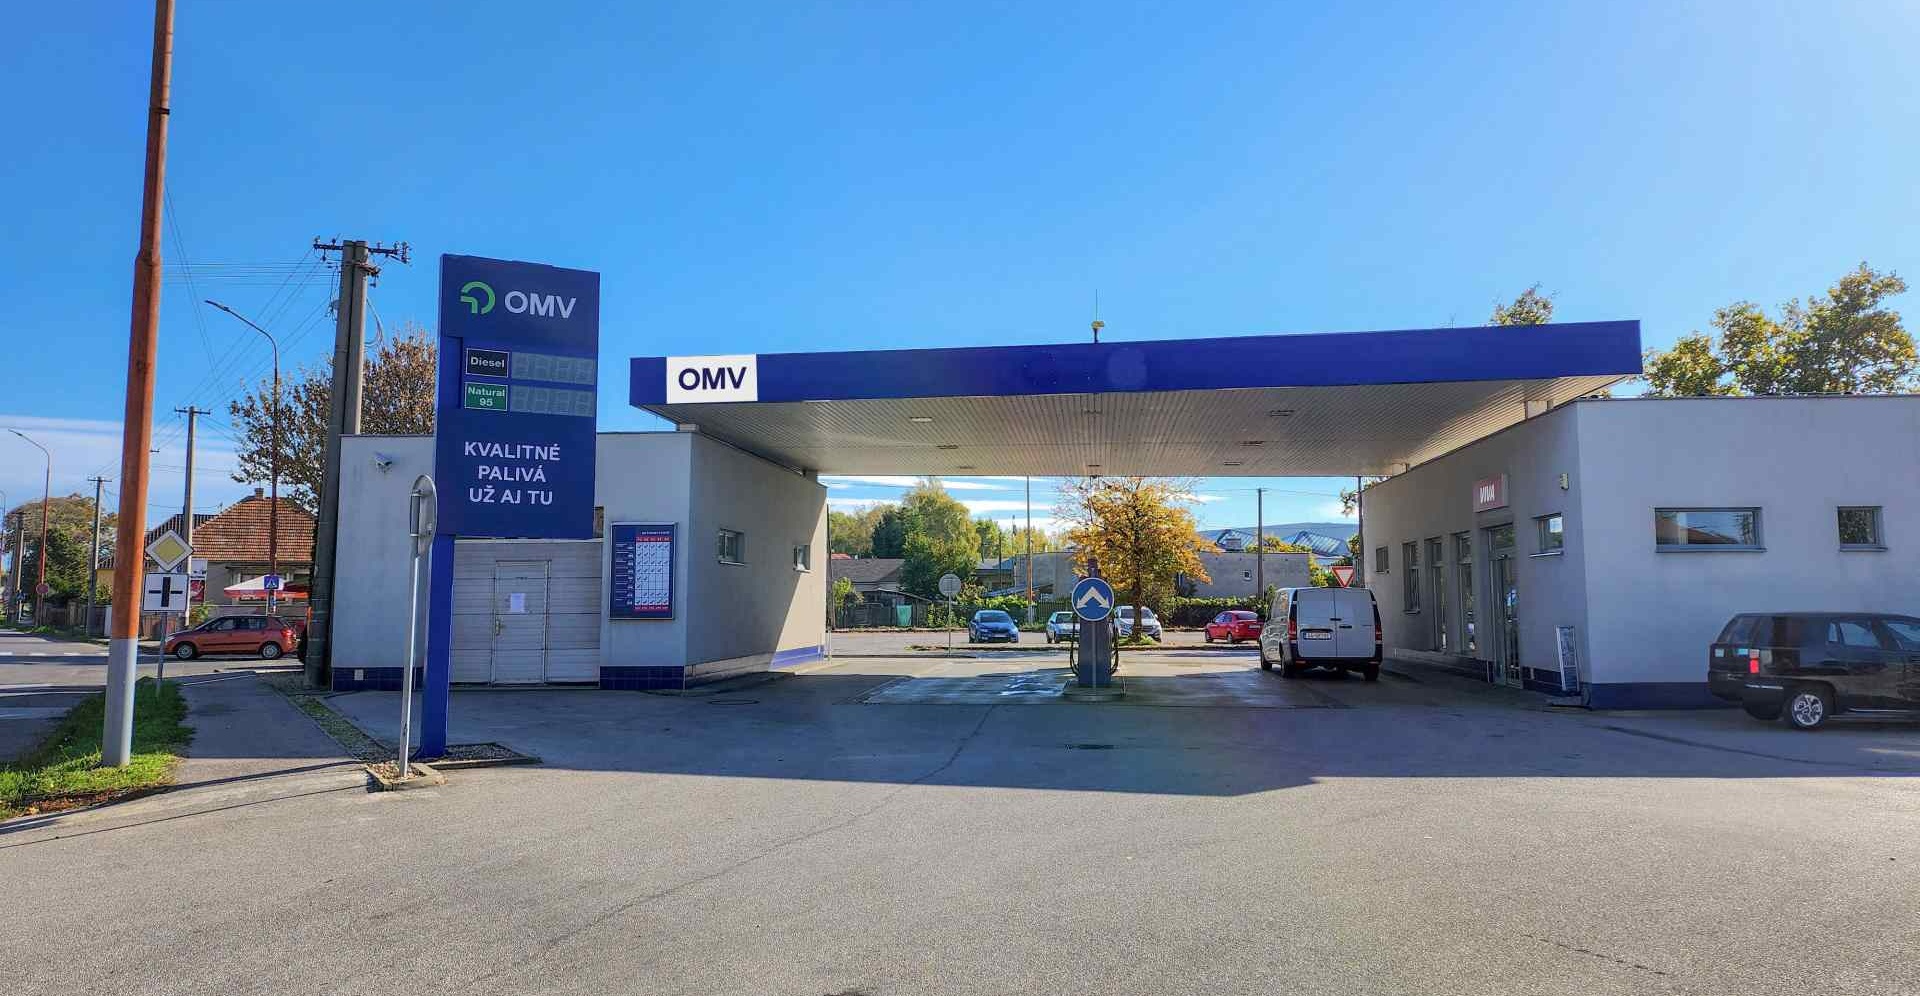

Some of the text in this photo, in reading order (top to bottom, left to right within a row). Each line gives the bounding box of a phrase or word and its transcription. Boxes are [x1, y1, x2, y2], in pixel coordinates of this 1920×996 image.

[505, 291, 577, 319] OMV
[470, 356, 505, 368] Diesel
[678, 366, 747, 391] OMV
[468, 386, 505, 397] Natural
[479, 397, 493, 407] 95
[464, 441, 561, 461] KVALITNÉ
[478, 465, 547, 483] PALIVÁ
[469, 484, 553, 505] UŽ AJ TU
